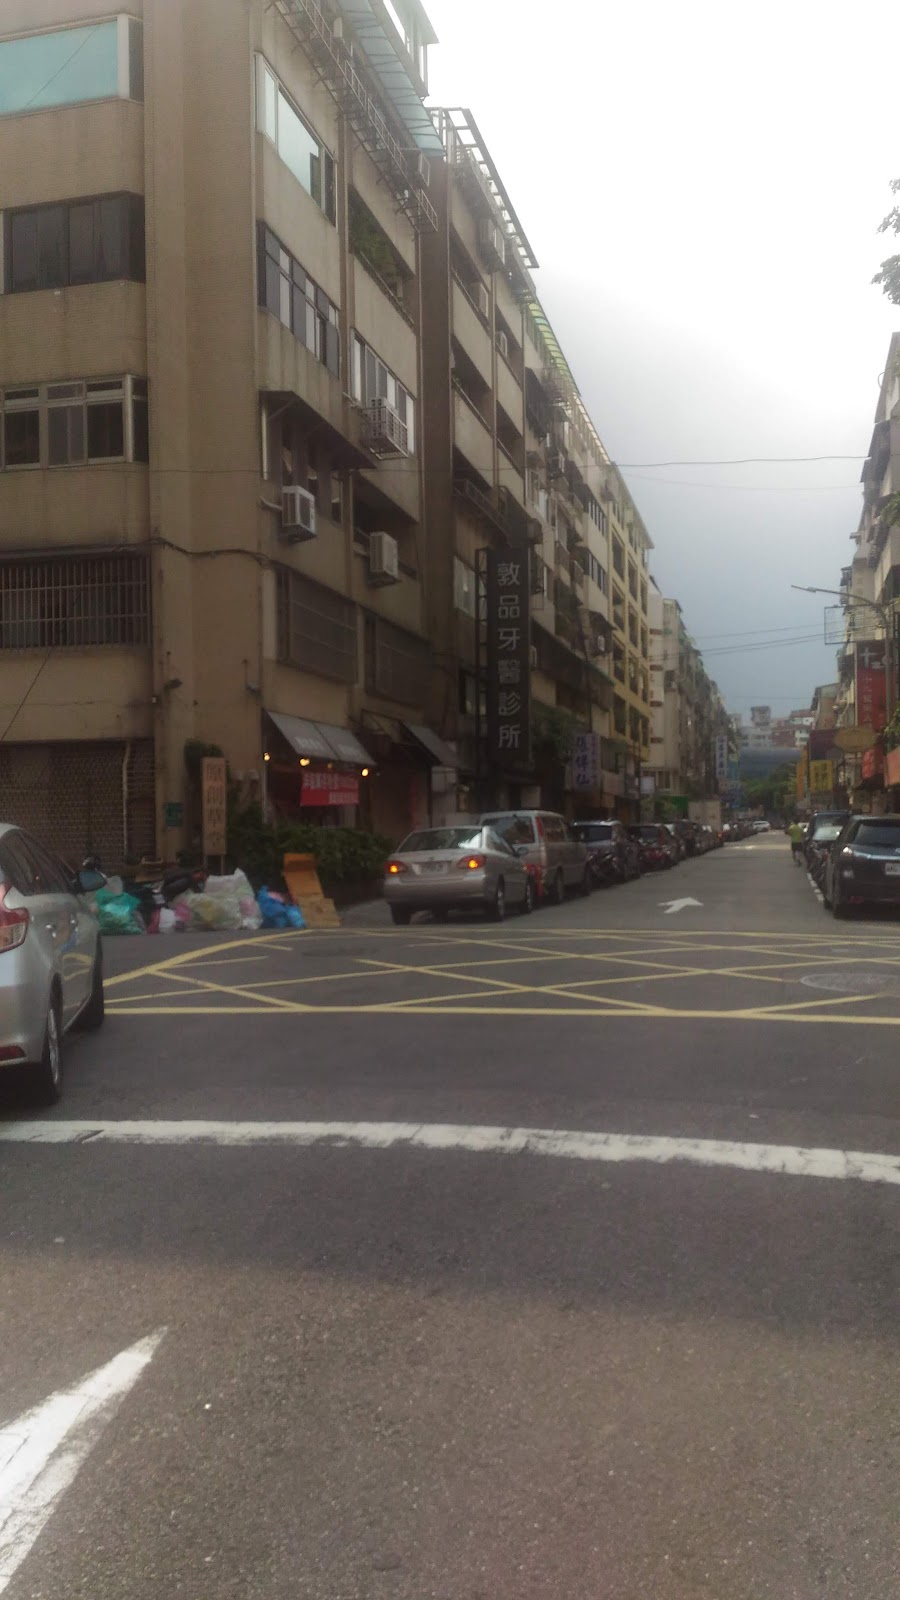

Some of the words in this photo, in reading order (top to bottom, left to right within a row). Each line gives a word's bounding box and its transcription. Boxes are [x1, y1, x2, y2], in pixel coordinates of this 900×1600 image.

[497, 563, 521, 748] 敦品牙醫診所
